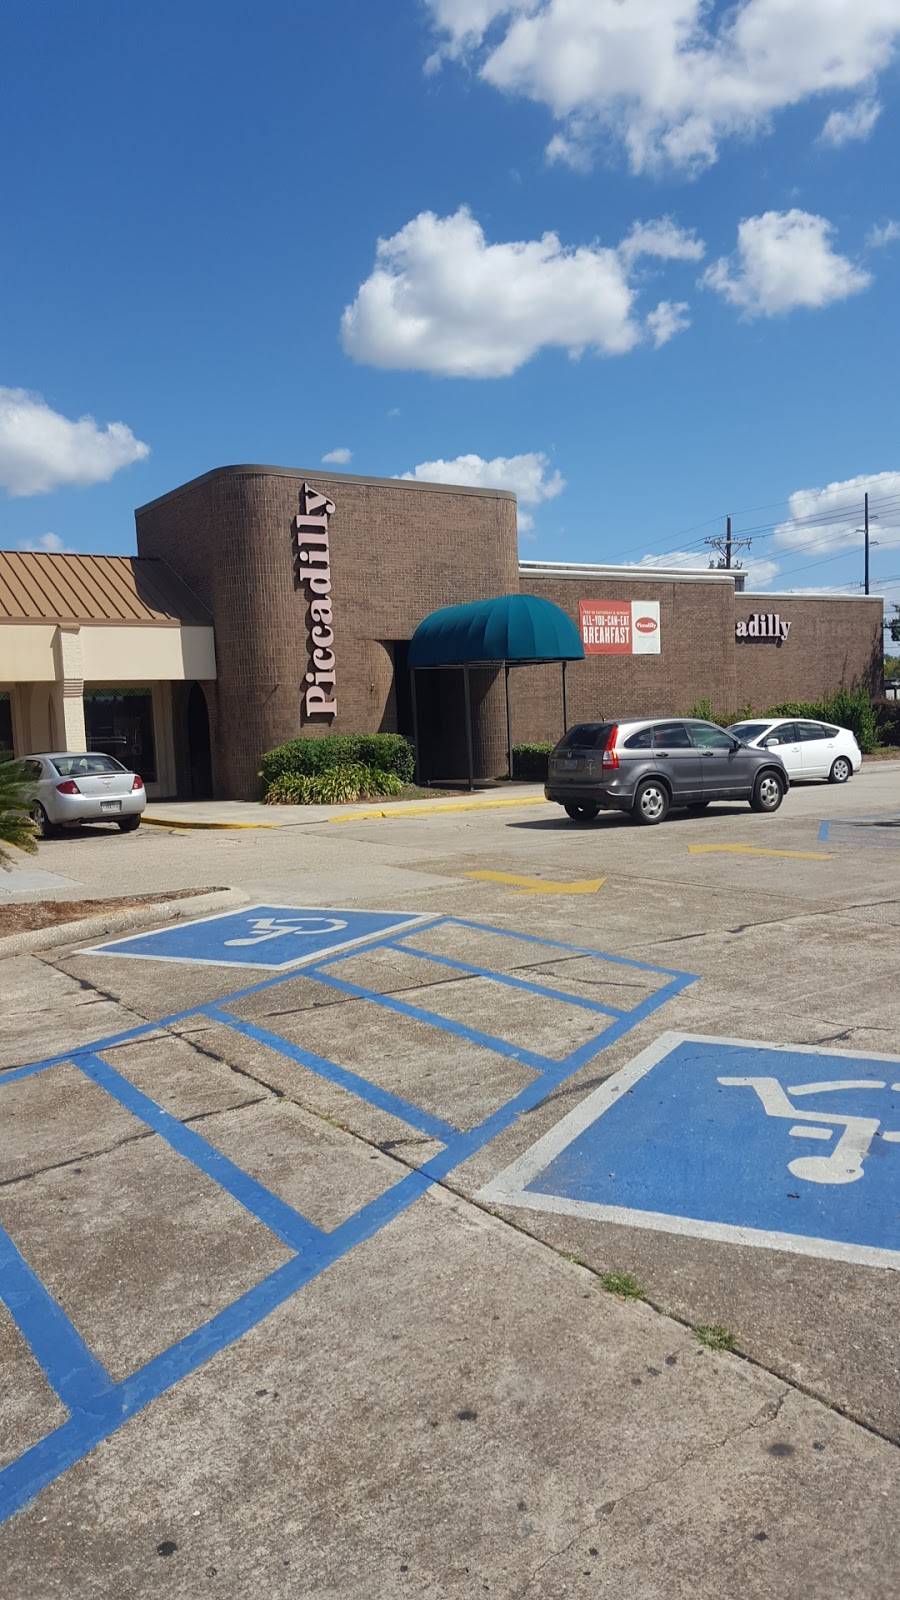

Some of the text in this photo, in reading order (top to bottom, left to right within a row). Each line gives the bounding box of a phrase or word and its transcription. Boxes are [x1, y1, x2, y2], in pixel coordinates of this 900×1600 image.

[296, 482, 337, 717] Piccadilly
[582, 615, 630, 626] ALL-YOU-CAN-EAT
[583, 626, 630, 644] BREAKFAST
